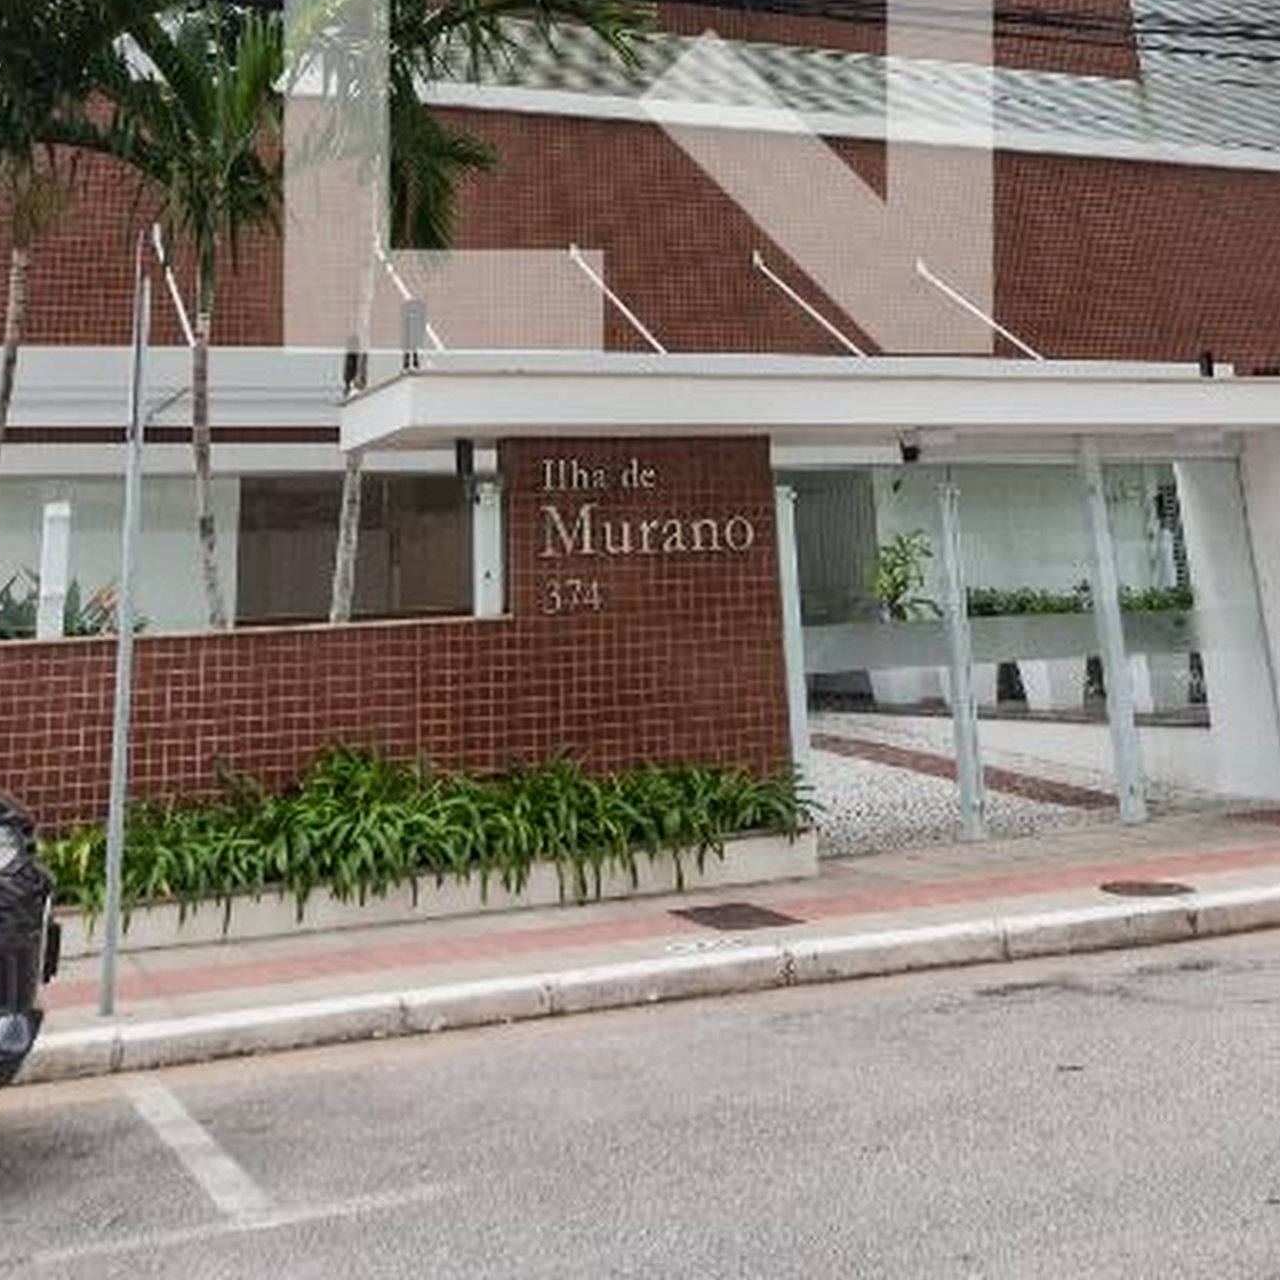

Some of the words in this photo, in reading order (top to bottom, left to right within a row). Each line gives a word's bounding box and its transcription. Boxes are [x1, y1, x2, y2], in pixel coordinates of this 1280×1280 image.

[542, 459, 606, 491] Ilha
[622, 458, 656, 488] de
[539, 503, 754, 558] Murano
[543, 578, 601, 614] 374
